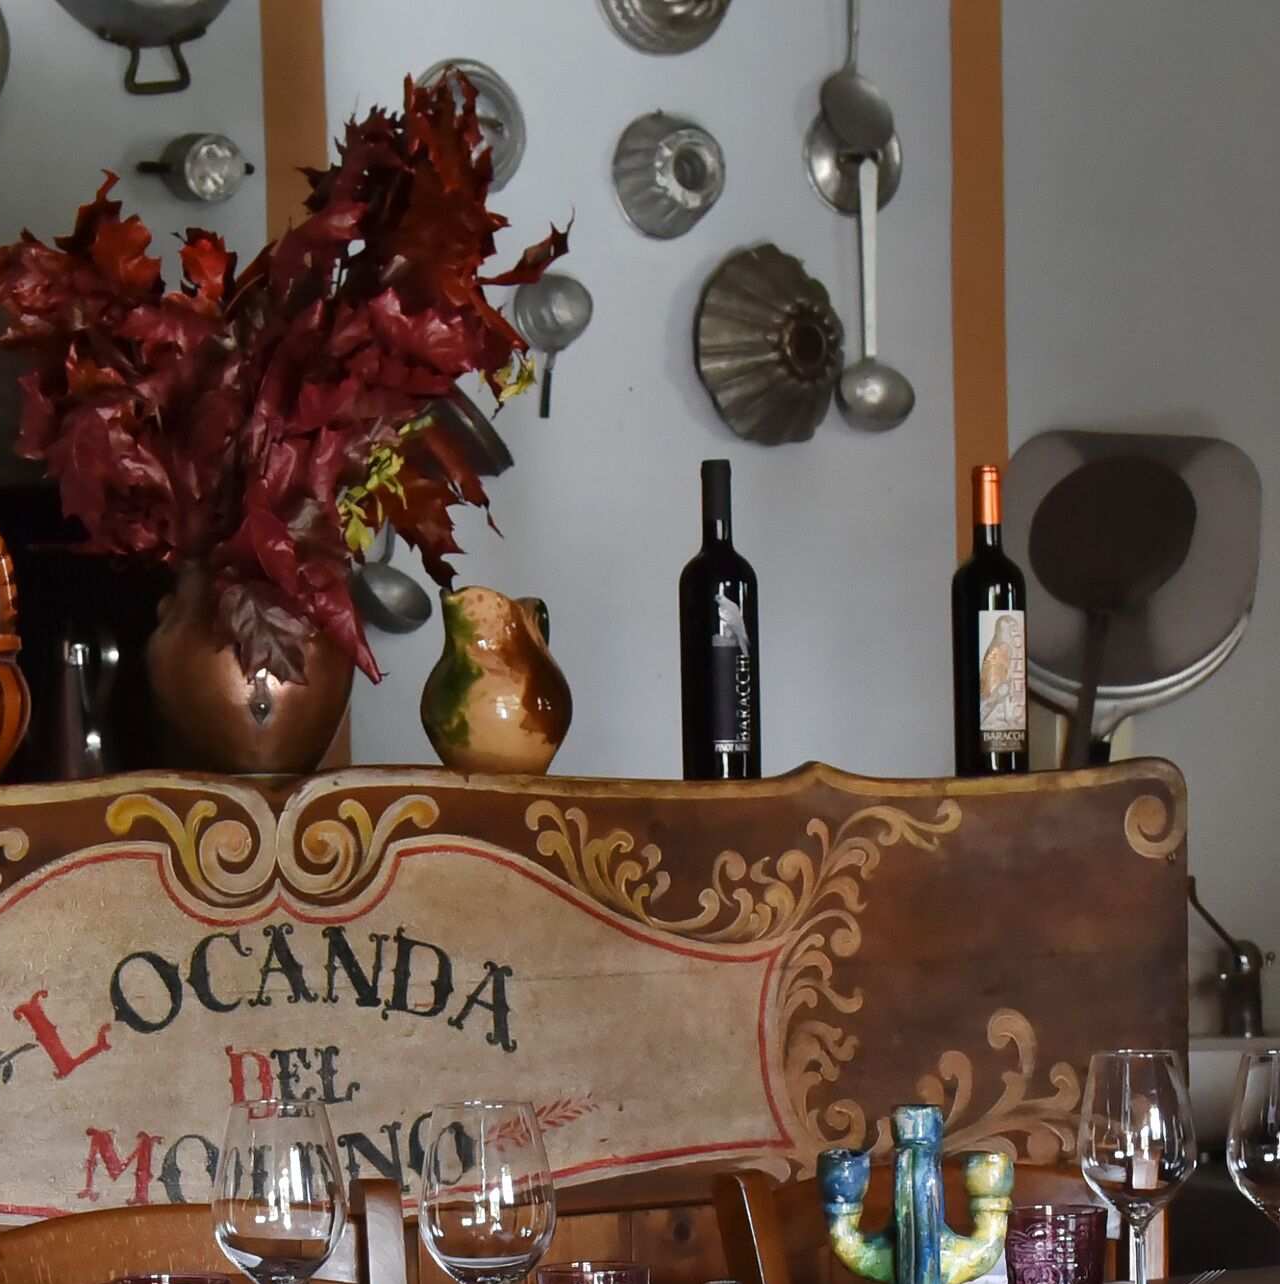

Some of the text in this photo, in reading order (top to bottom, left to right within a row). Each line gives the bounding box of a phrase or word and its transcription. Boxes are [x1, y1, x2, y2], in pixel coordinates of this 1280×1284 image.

[735, 654, 751, 741] BARACCHI
[714, 743, 734, 752] PINOT
[12, 922, 518, 1079] LOCANDA
[225, 1045, 360, 1117] DEL
